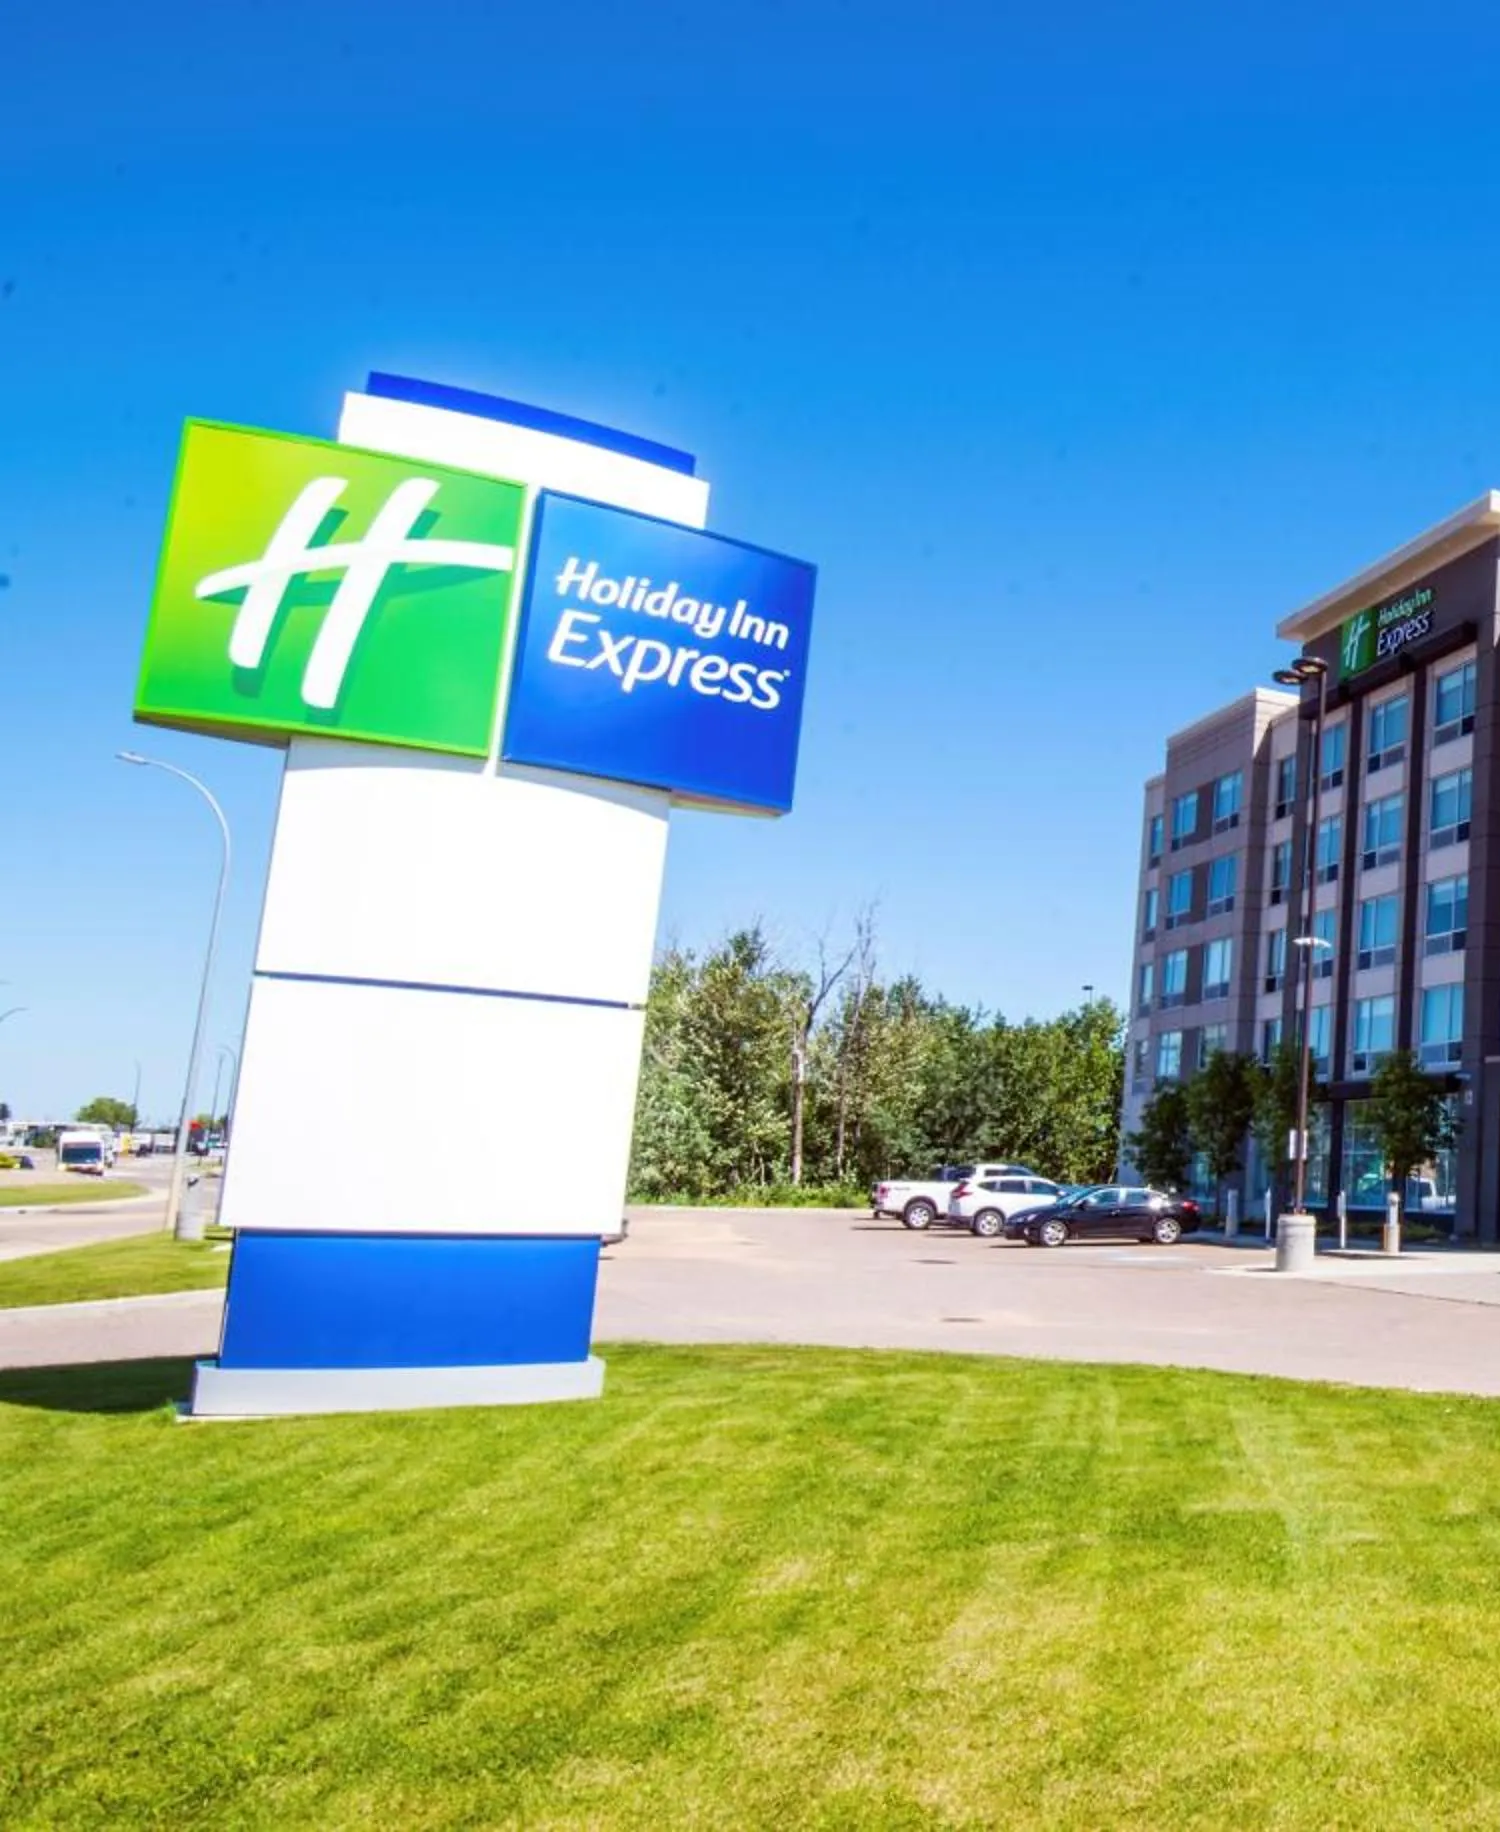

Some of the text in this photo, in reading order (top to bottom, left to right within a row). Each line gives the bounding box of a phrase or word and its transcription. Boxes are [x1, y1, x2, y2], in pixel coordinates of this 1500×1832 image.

[195, 476, 514, 709] H
[556, 556, 789, 651] Holiday Inn
[1377, 611, 1432, 657] Express
[547, 608, 784, 710] Express
